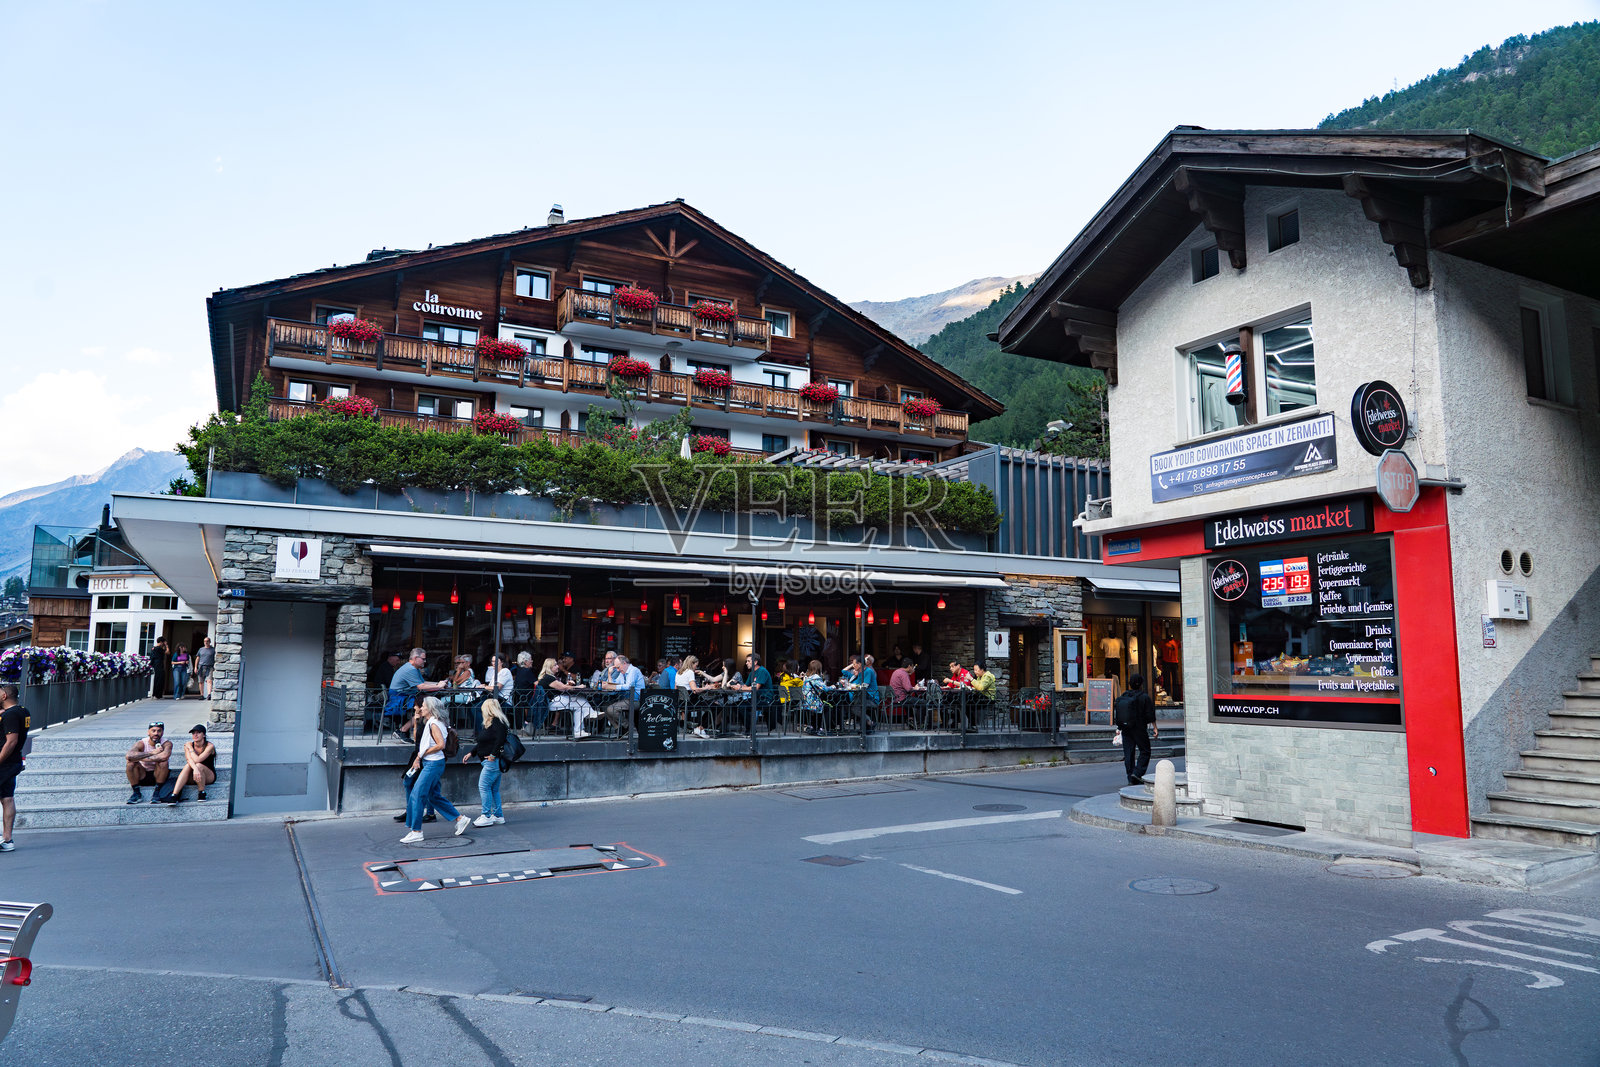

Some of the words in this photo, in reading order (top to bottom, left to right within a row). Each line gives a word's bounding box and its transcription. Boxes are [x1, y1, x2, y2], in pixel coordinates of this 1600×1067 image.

[425, 289, 439, 304] la
[413, 301, 483, 320] couronne
[1366, 408, 1397, 425] Edelweiss
[1378, 419, 1402, 433] market
[1154, 457, 1173, 472] BOOK
[1175, 452, 1195, 467] YOUR
[1196, 442, 1245, 463] COWORKING
[1246, 435, 1273, 451] SPACE
[1275, 431, 1285, 445] IN
[1286, 419, 1331, 442] ZERMATT!
[1169, 470, 1184, 484] +41
[1187, 468, 1198, 480] 78
[1200, 465, 1219, 478] 898
[1220, 462, 1231, 474] 17
[1233, 459, 1246, 471] 55
[1383, 471, 1412, 490] STOP
[1214, 517, 1285, 546] Edelweiss
[1290, 504, 1353, 532] market
[1317, 562, 1367, 577] Fertiggerichte
[93, 578, 129, 590] HOTEL
[1212, 571, 1241, 590] Edelweiss
[1223, 578, 1246, 593] market
[1263, 577, 1285, 591] 235
[1318, 576, 1361, 590] Supermarkt
[1319, 590, 1342, 603] Kaffee
[1320, 603, 1347, 616] Früchte
[1348, 602, 1362, 613] und
[1363, 601, 1393, 614] Gemüse
[1365, 624, 1392, 637] Drinks
[1329, 639, 1373, 652] Conveniance
[1375, 638, 1393, 651] Food
[1345, 652, 1394, 665] Supermarket
[1371, 666, 1394, 678] Coffee
[1318, 679, 1339, 691] Fruits
[1340, 680, 1354, 690] and
[1355, 679, 1395, 692] Vegetables
[1218, 704, 1280, 715] WWW.CVDP.CH
